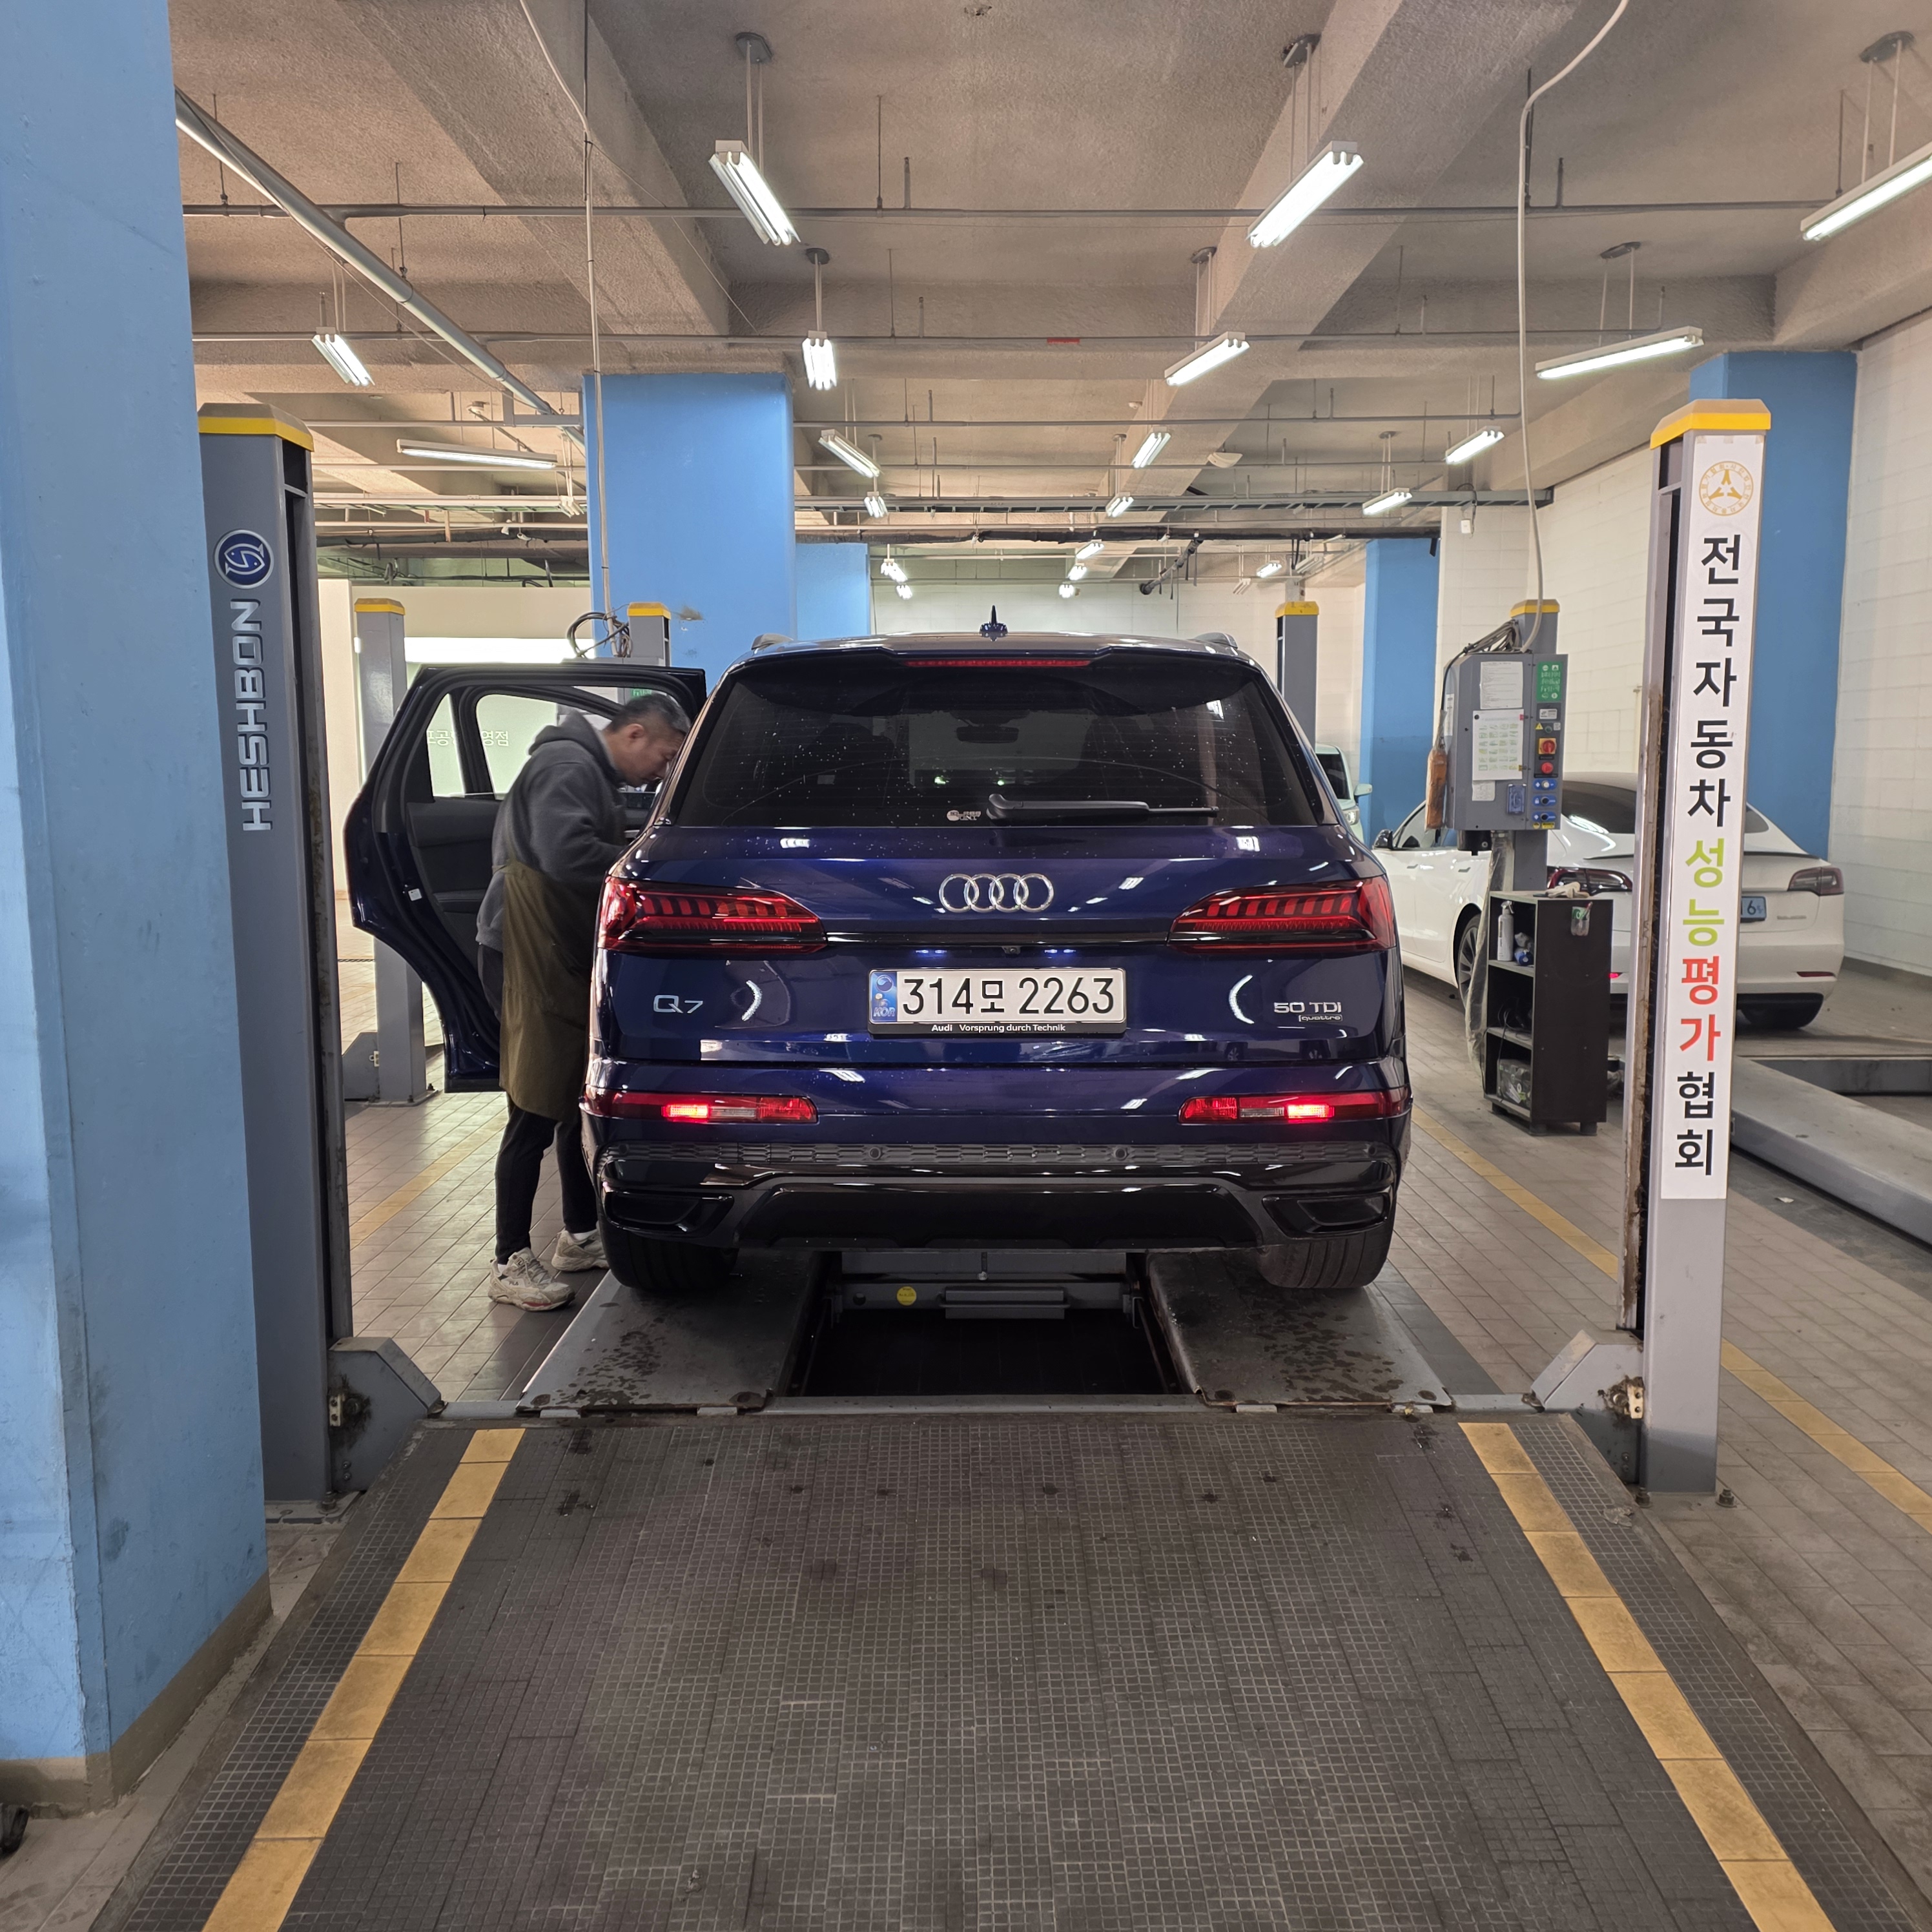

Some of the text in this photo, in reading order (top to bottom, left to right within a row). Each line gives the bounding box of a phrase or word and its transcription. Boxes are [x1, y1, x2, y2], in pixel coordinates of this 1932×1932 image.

[230, 599, 272, 831] HESHBON
[903, 977, 1114, 1014] 314모 2263
[653, 994, 703, 1013] Q7
[1273, 1002, 1342, 1013] 50 TDI
[873, 1007, 896, 1017] KOR
[959, 1024, 1005, 1033] Vorsprung
